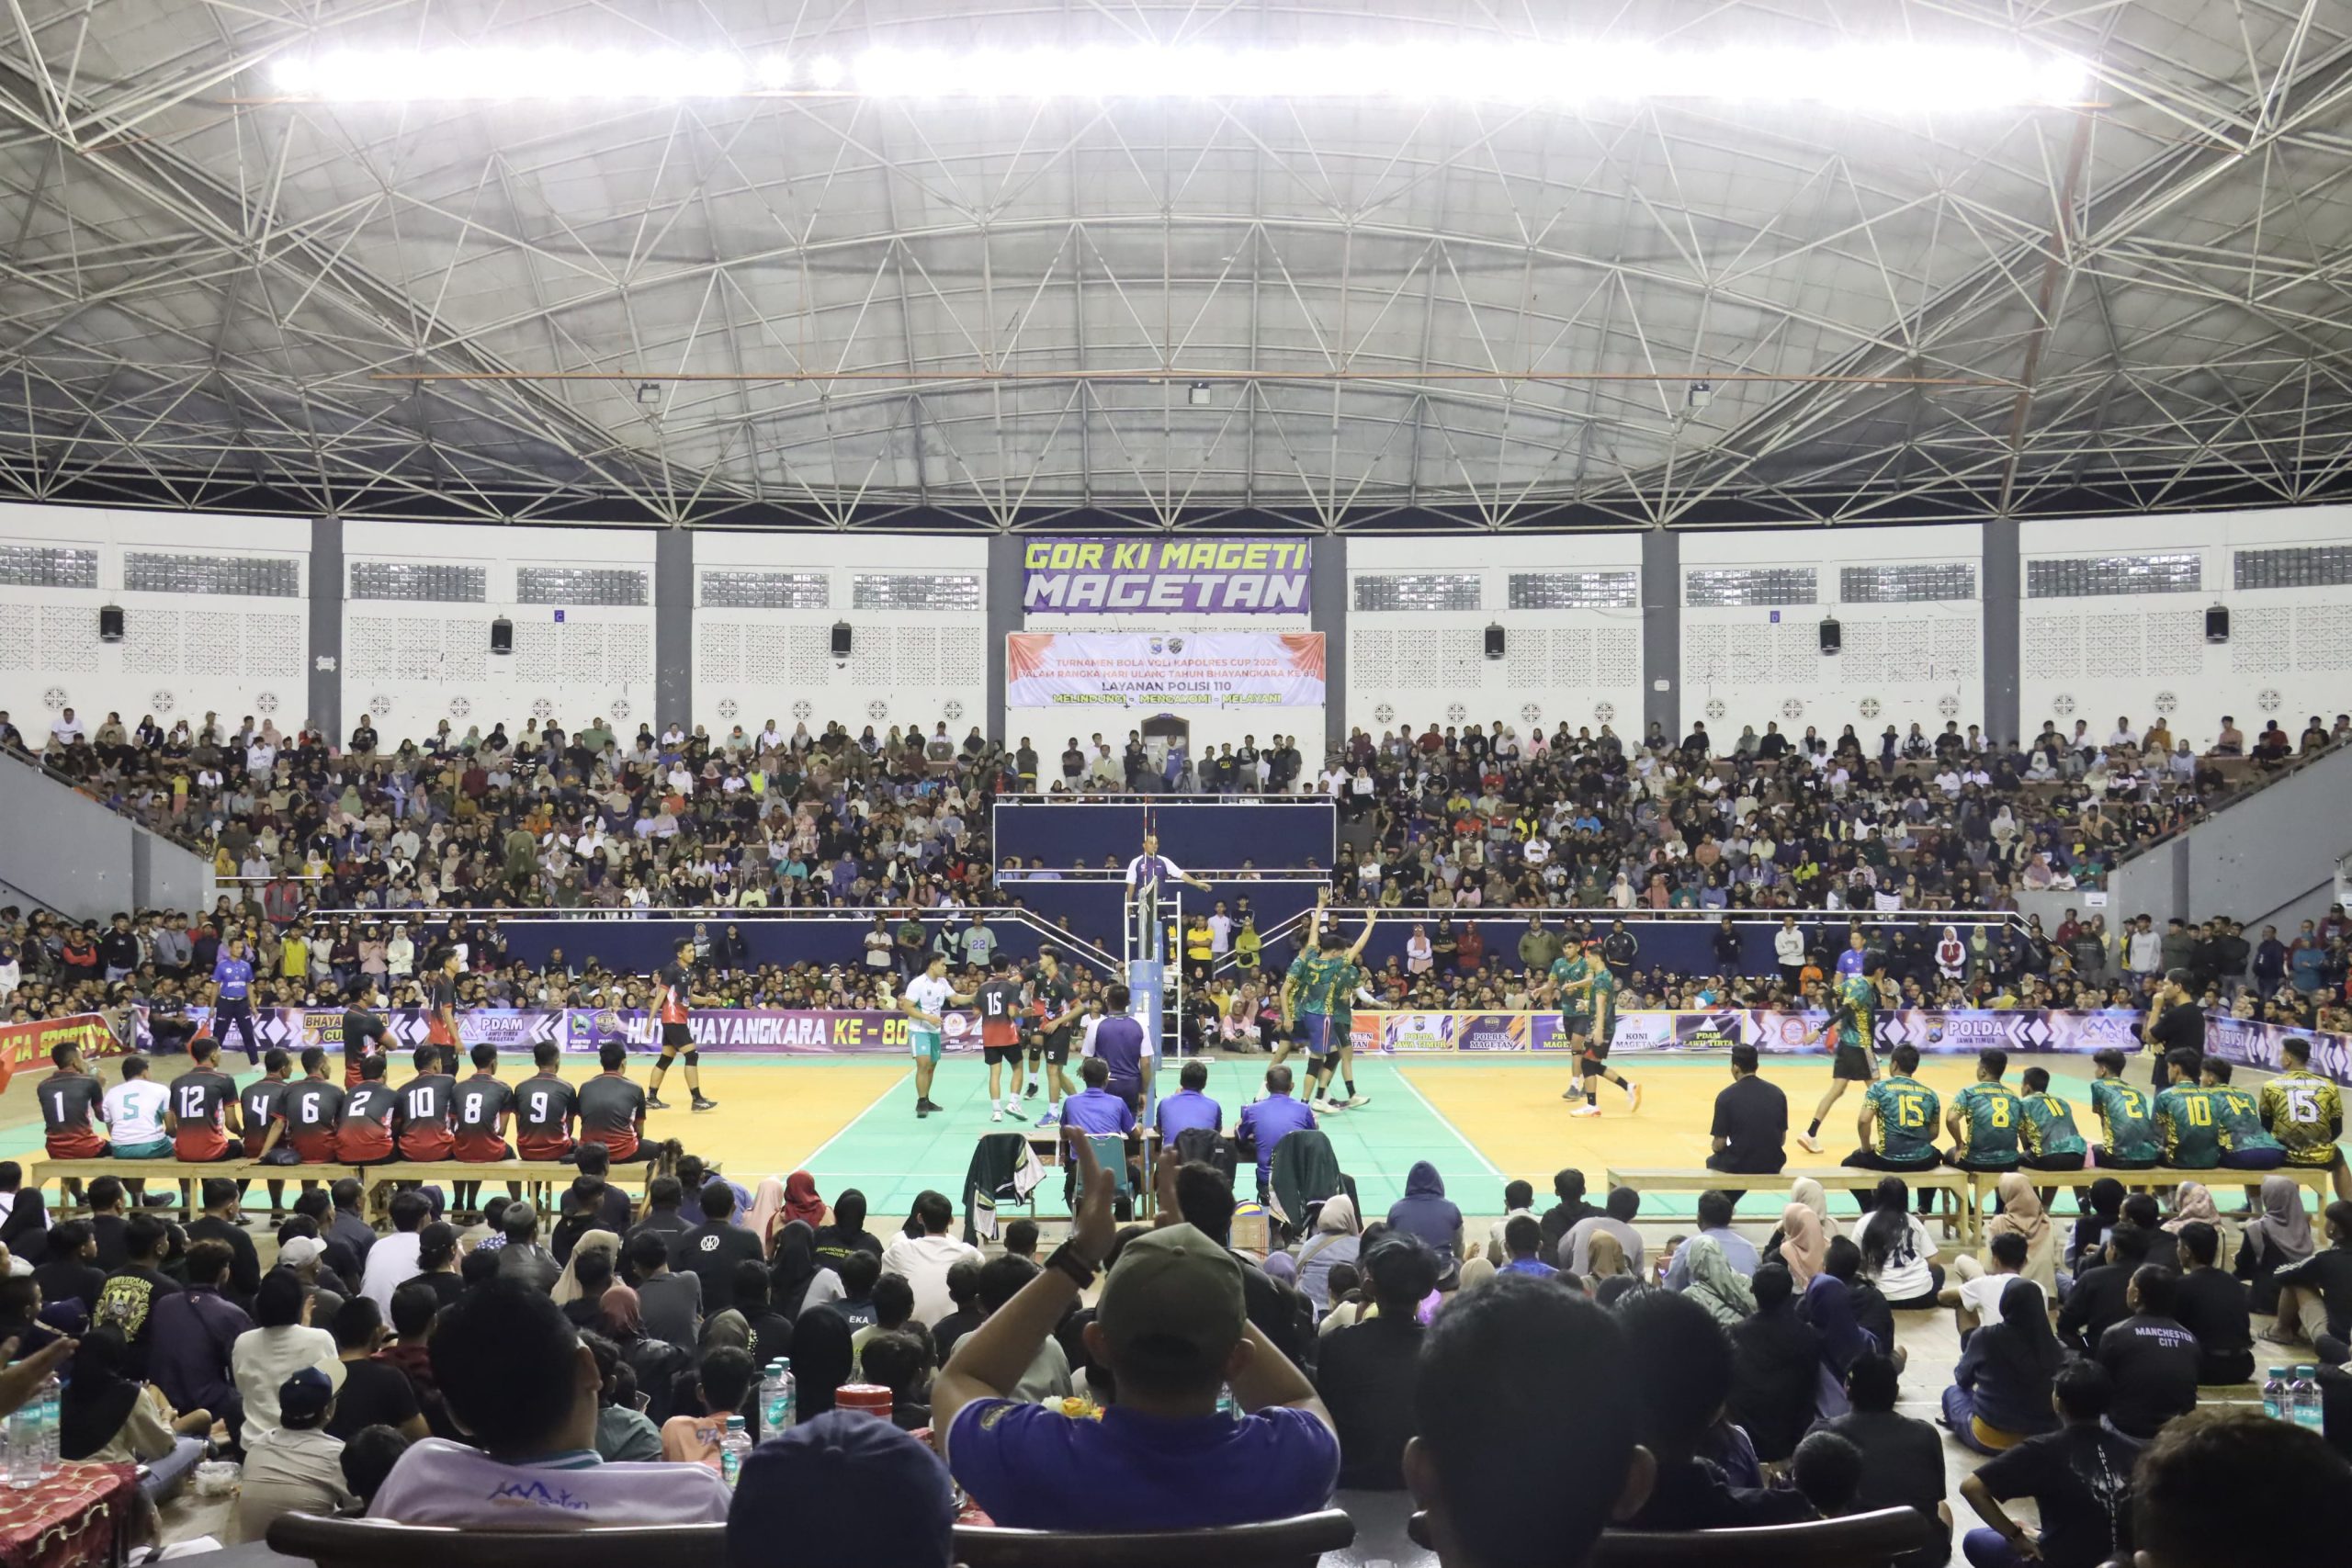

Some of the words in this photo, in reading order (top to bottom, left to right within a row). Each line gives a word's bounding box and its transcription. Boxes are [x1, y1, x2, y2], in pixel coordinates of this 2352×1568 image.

[1024, 543, 1103, 570] GOR
[1111, 543, 1152, 570] KI
[1159, 543, 1306, 570] MAGETI
[1023, 574, 1307, 608] MAGETAN
[1057, 659, 1114, 667] TURNAMEN
[1116, 659, 1145, 667] BOLA
[1173, 659, 1228, 667] KAPOLRES
[1230, 659, 1251, 667] CUP
[1057, 670, 1101, 678] RANGKA
[1131, 670, 1166, 678] ULANG
[1169, 670, 1204, 678] TAHUN
[1206, 670, 1283, 678] BHAYANGKARA
[1052, 694, 1126, 704] MELINDUNGI
[1139, 694, 1213, 704] MENGAYOMI
[1222, 694, 1282, 704] MELAYANI
[1102, 682, 1164, 691] LAYANAN
[1168, 682, 1210, 691] POLISI
[1214, 682, 1232, 691] 110
[973, 940, 986, 950] 22
[481, 1018, 524, 1031] PDAM
[689, 1017, 827, 1044] HAYANGKARA
[832, 1018, 863, 1044] KE
[882, 1019, 909, 1044] 80
[1696, 1032, 1721, 1040] PDAM
[1948, 1020, 2006, 1037] POLDA
[53, 1090, 65, 1123] 1
[122, 1092, 141, 1121] 5
[179, 1085, 205, 1118] 12
[251, 1094, 269, 1126] 4
[301, 1091, 321, 1123] 6
[347, 1090, 372, 1117] 2
[408, 1087, 435, 1120] 10
[464, 1092, 483, 1124] 8
[529, 1091, 548, 1123] 9
[1898, 1094, 1925, 1127] 15
[1991, 1097, 2009, 1128] 8
[2042, 1098, 2064, 1117] 11
[2120, 1089, 2143, 1119] 2
[2185, 1096, 2212, 1126] 10
[2286, 1089, 2318, 1123] 15
[849, 1315, 869, 1324] EKA
[2134, 1327, 2194, 1344] MANCHESTER
[2158, 1337, 2179, 1348] CITY
